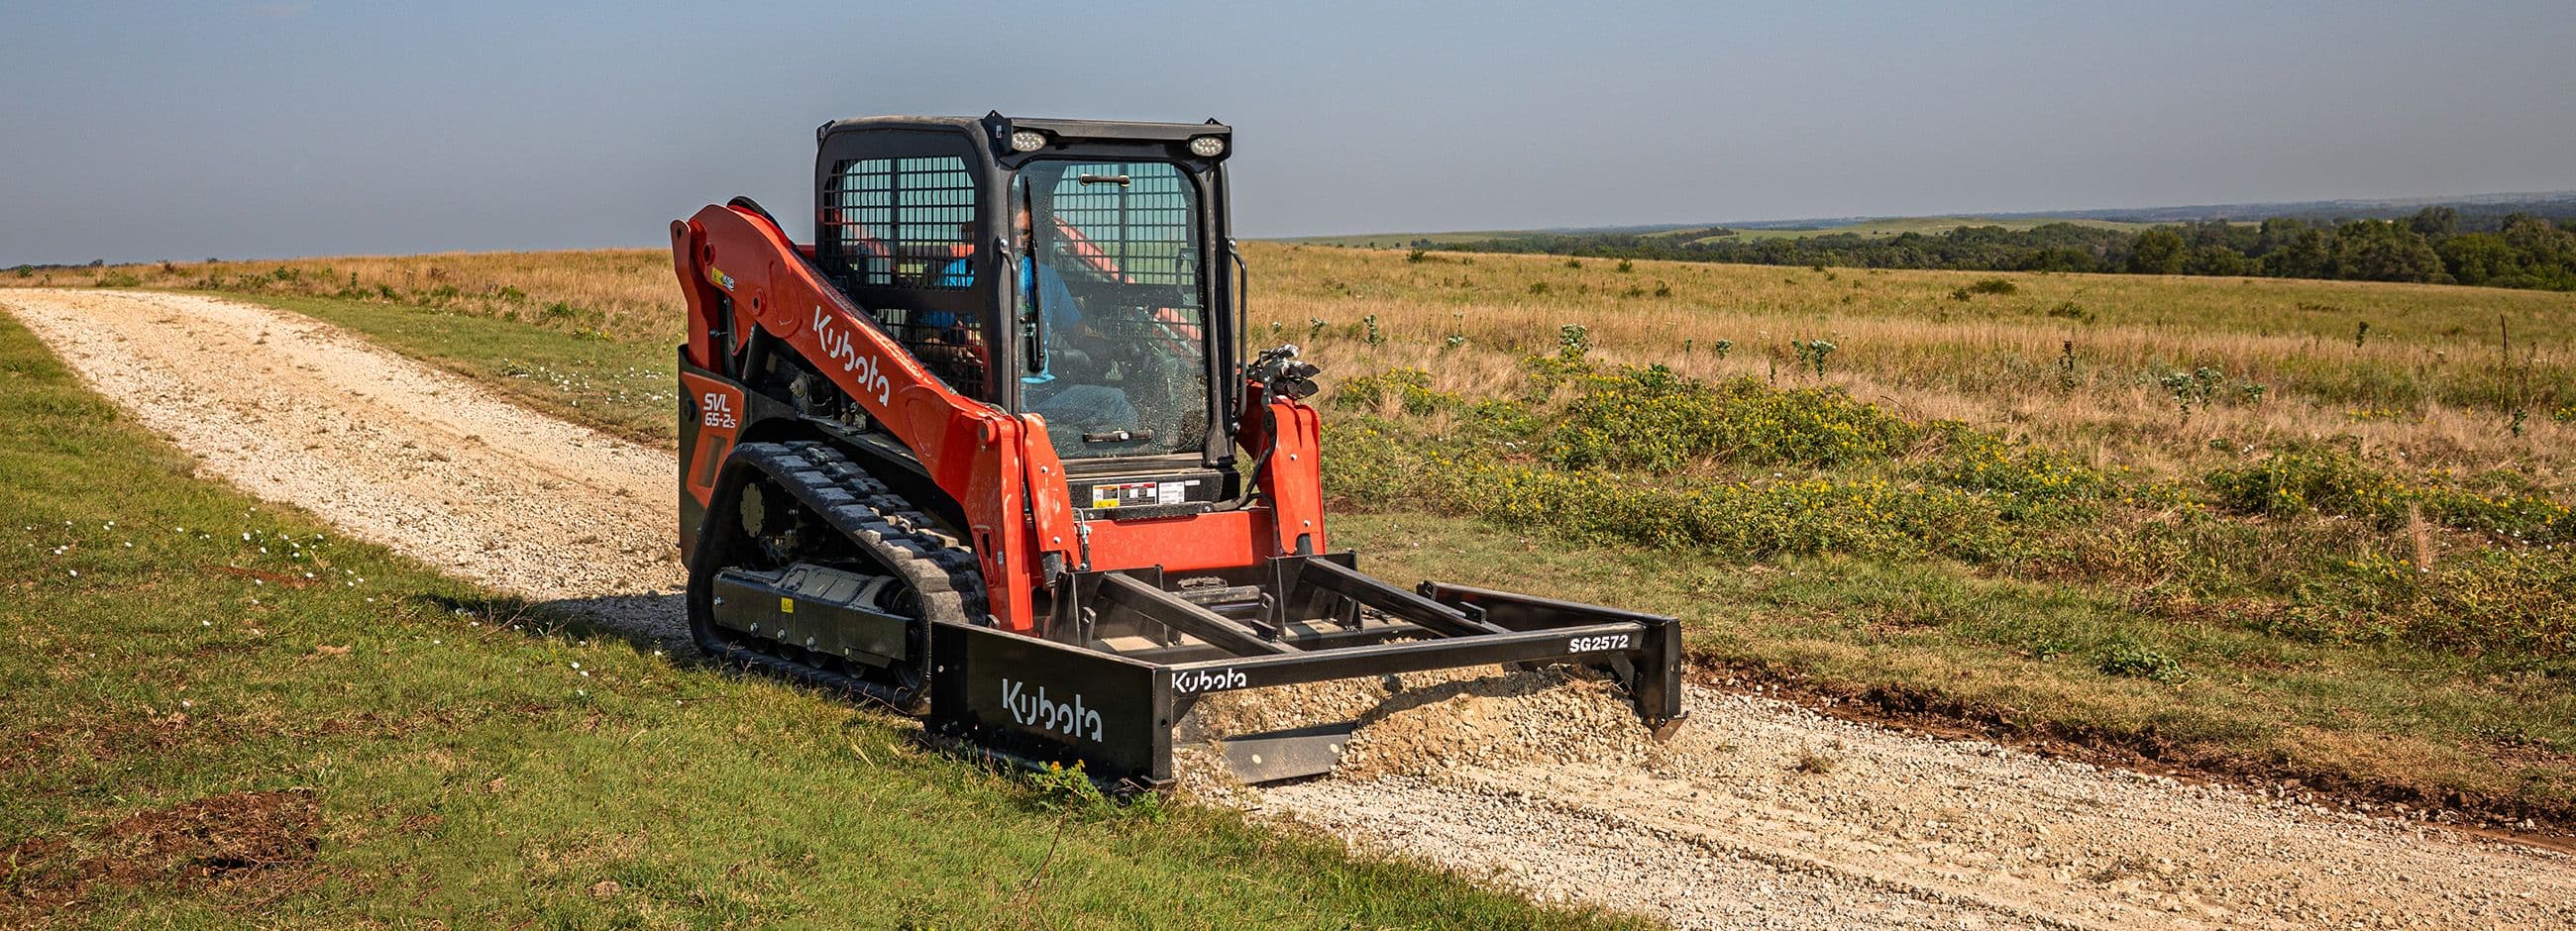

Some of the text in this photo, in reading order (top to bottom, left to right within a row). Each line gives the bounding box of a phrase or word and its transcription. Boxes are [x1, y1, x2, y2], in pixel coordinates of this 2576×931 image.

[813, 305, 890, 407] Kubota
[703, 392, 731, 412] SVL
[1569, 634, 1629, 653] SG2572
[1171, 668, 1246, 693] Kubota
[1003, 678, 1102, 742] Kubota
